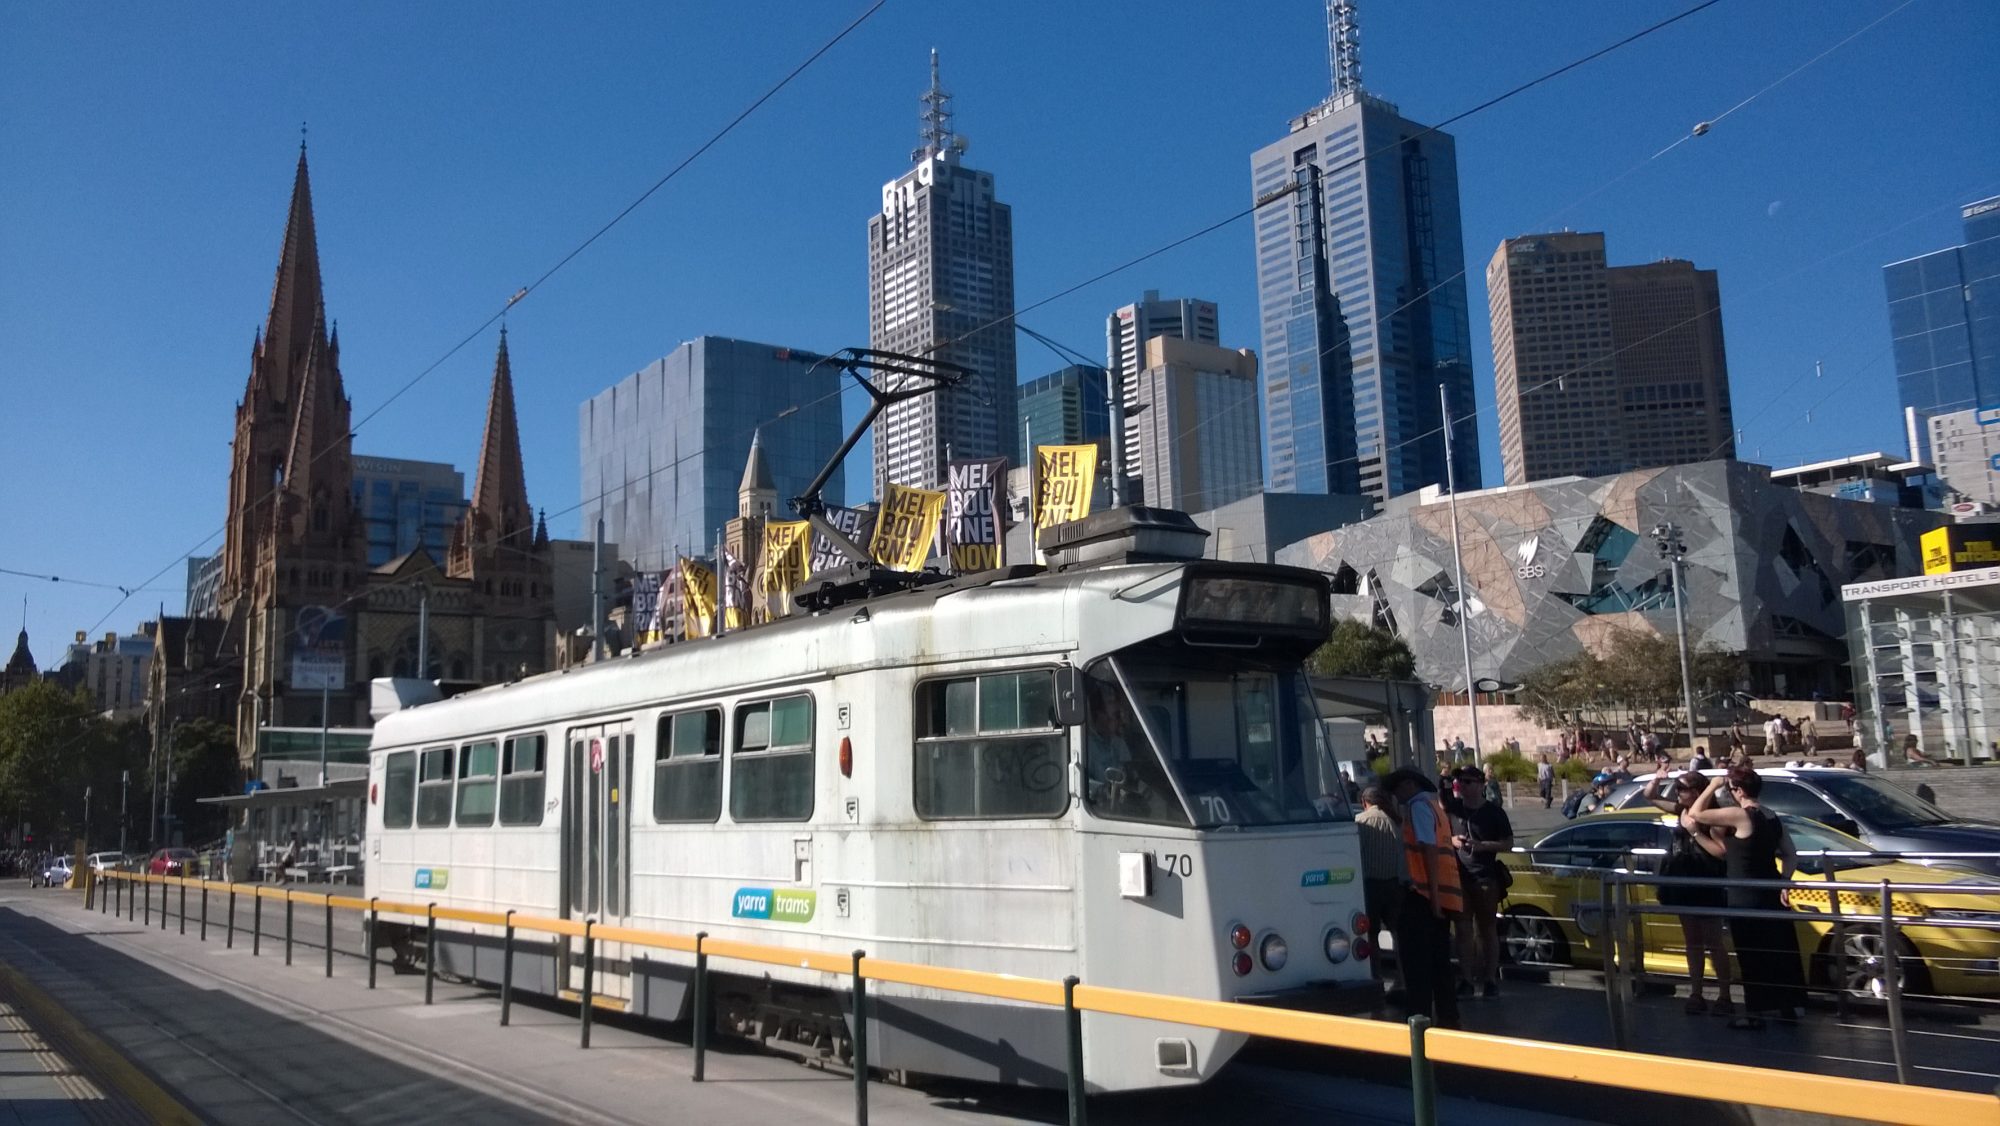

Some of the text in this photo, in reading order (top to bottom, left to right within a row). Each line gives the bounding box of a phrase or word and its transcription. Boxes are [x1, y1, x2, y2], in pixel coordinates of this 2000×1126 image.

[950, 464, 992, 489] MEL
[1039, 451, 1080, 478] MEL
[887, 487, 926, 516] MEL
[950, 489, 993, 516] BOU
[1039, 479, 1079, 506] BOU
[767, 526, 798, 547] MEL
[881, 512, 925, 541] BOU
[950, 516, 994, 543] RNE
[767, 541, 800, 569] BOU
[876, 537, 916, 565] RNE
[951, 544, 998, 571] NOW
[1517, 564, 1545, 579] SBS
[1843, 579, 1929, 597] TRANSPORT
[1934, 573, 1984, 587] HOTEL
[1201, 796, 1231, 823] 70
[1164, 854, 1193, 878] 70
[1305, 872, 1325, 885] yarra
[738, 895, 810, 914] yarra trams
